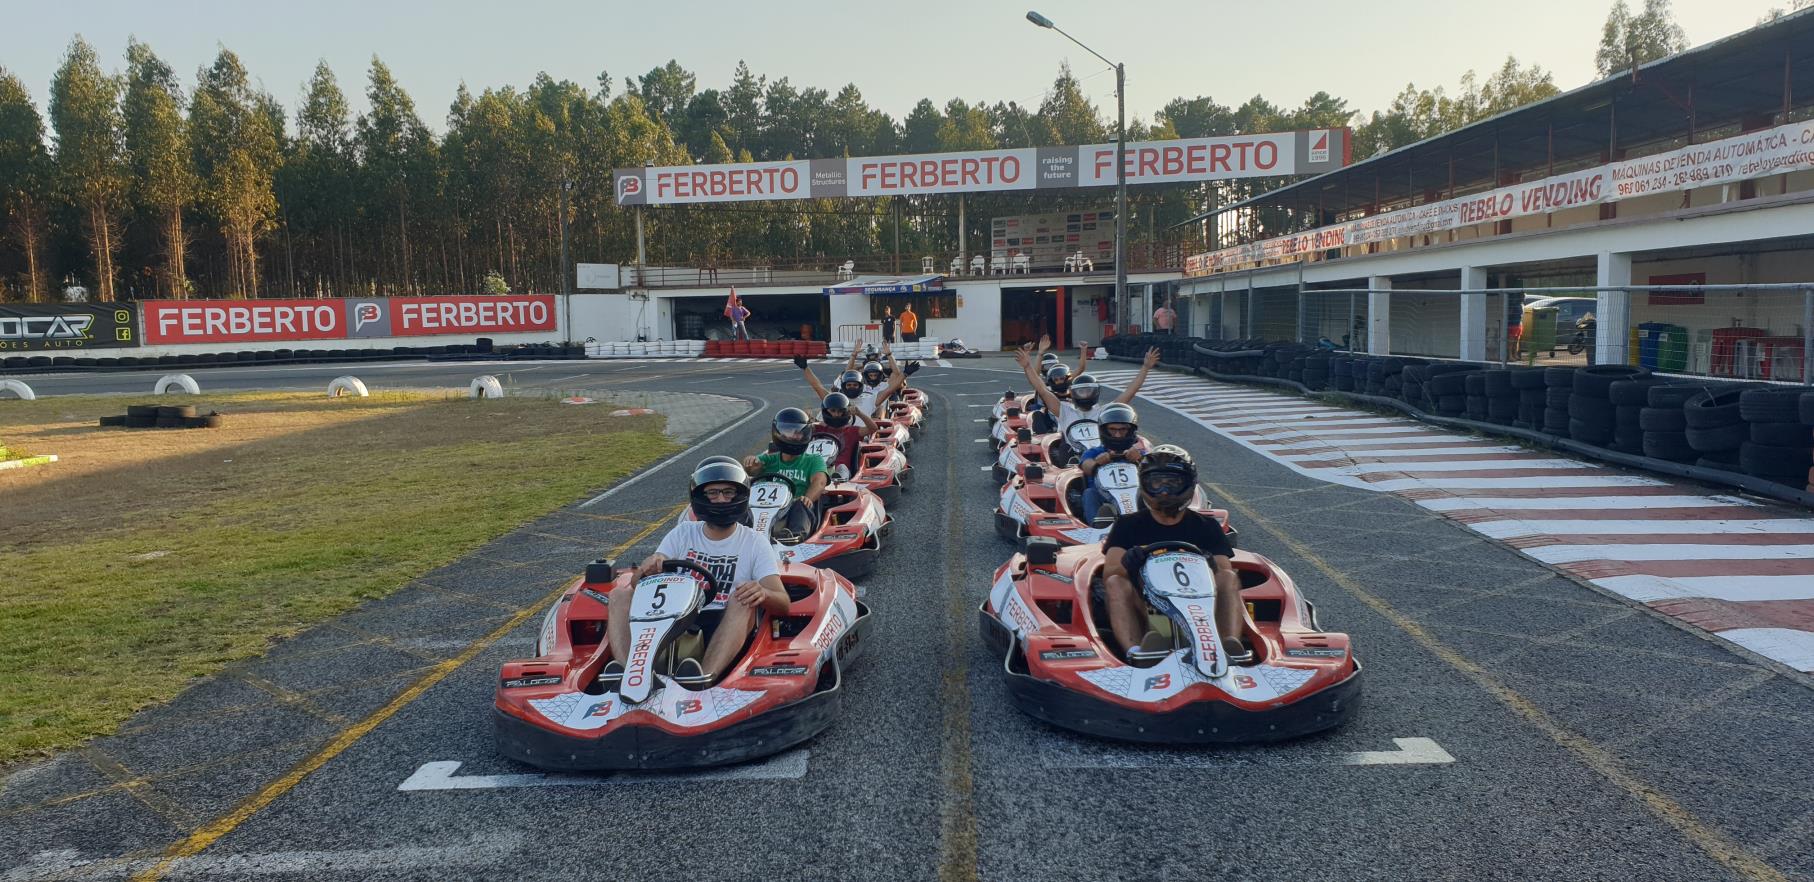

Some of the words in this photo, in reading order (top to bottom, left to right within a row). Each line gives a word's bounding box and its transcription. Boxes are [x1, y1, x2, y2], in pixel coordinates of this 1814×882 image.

[1042, 156, 1073, 165] raising
[1094, 139, 1278, 179] FERBERTO
[657, 166, 799, 198] FERBERTO
[811, 178, 847, 187] Structures
[815, 170, 842, 179] Metallic
[862, 154, 1020, 190] FERBERTO
[1043, 171, 1072, 179] future
[1459, 192, 1513, 224] REBELO
[1521, 174, 1602, 214] VENDING
[159, 305, 337, 336] FERBERTO
[402, 301, 548, 328] FERBERTO
[44, 340, 83, 348] AUTO
[1078, 427, 1091, 437] 11
[810, 443, 823, 454] 14
[1109, 468, 1128, 484] 15
[757, 487, 778, 502] 24
[1173, 562, 1190, 587] 6
[652, 584, 668, 610] 5
[1187, 604, 1219, 662] FERBERTO
[628, 627, 657, 687] FERBERTO
